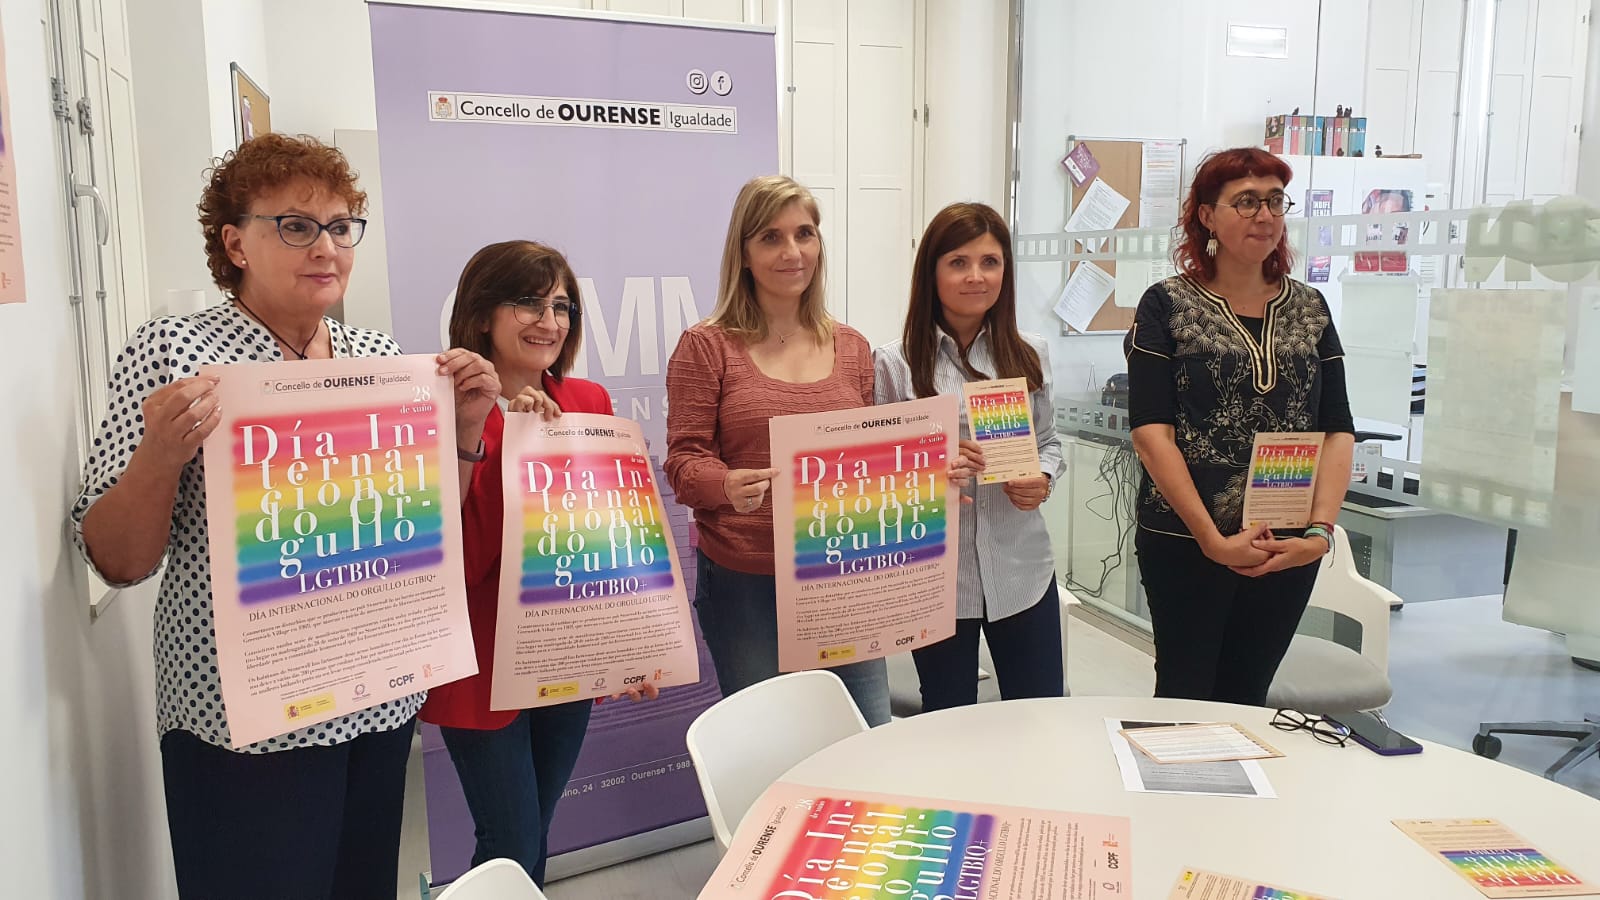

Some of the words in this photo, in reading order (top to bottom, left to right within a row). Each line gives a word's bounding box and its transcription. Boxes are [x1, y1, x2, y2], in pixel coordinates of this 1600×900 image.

[460, 101, 530, 118] Concello
[536, 105, 554, 120] de
[558, 104, 661, 126] OURENSE
[670, 112, 732, 128] Igualdade
[275, 380, 311, 392] Concello
[313, 380, 323, 388] de
[324, 376, 376, 388] OURENSE
[412, 386, 431, 402] 28
[400, 404, 410, 414] de
[584, 428, 615, 438] OURENSE
[862, 417, 902, 430] OURENSE
[240, 420, 336, 466] Día
[366, 413, 438, 450] In-
[522, 459, 596, 492] Día
[798, 452, 869, 484] Día
[894, 445, 944, 472] In-
[256, 500, 318, 542] do
[808, 508, 854, 538] do
[538, 522, 584, 556] do
[840, 551, 916, 575] LGTBIQ+
[299, 557, 402, 594] LGTBIQ+
[816, 577, 872, 590] INTERNACIONAL
[874, 574, 884, 582] DO
[570, 576, 647, 600] LGTBIQ+
[250, 610, 266, 622] DÍA
[268, 595, 344, 618] INTERNACIONAL
[346, 592, 360, 600] DO
[361, 580, 402, 596] ORGULLO
[525, 608, 540, 618] DÍA
[542, 603, 602, 616] INTERNACIONAL
[605, 601, 614, 609] DO
[896, 636, 914, 646] CCPF
[389, 673, 415, 689] CCPF
[624, 675, 646, 684] CCPF
[583, 784, 593, 792] 24
[600, 776, 626, 788] 32002
[631, 767, 666, 780] Ourense
[676, 760, 690, 770] 988
[752, 824, 776, 856] OURENSE
[954, 840, 992, 900] LGTBIQ+
[1108, 852, 1118, 869] CCPF
